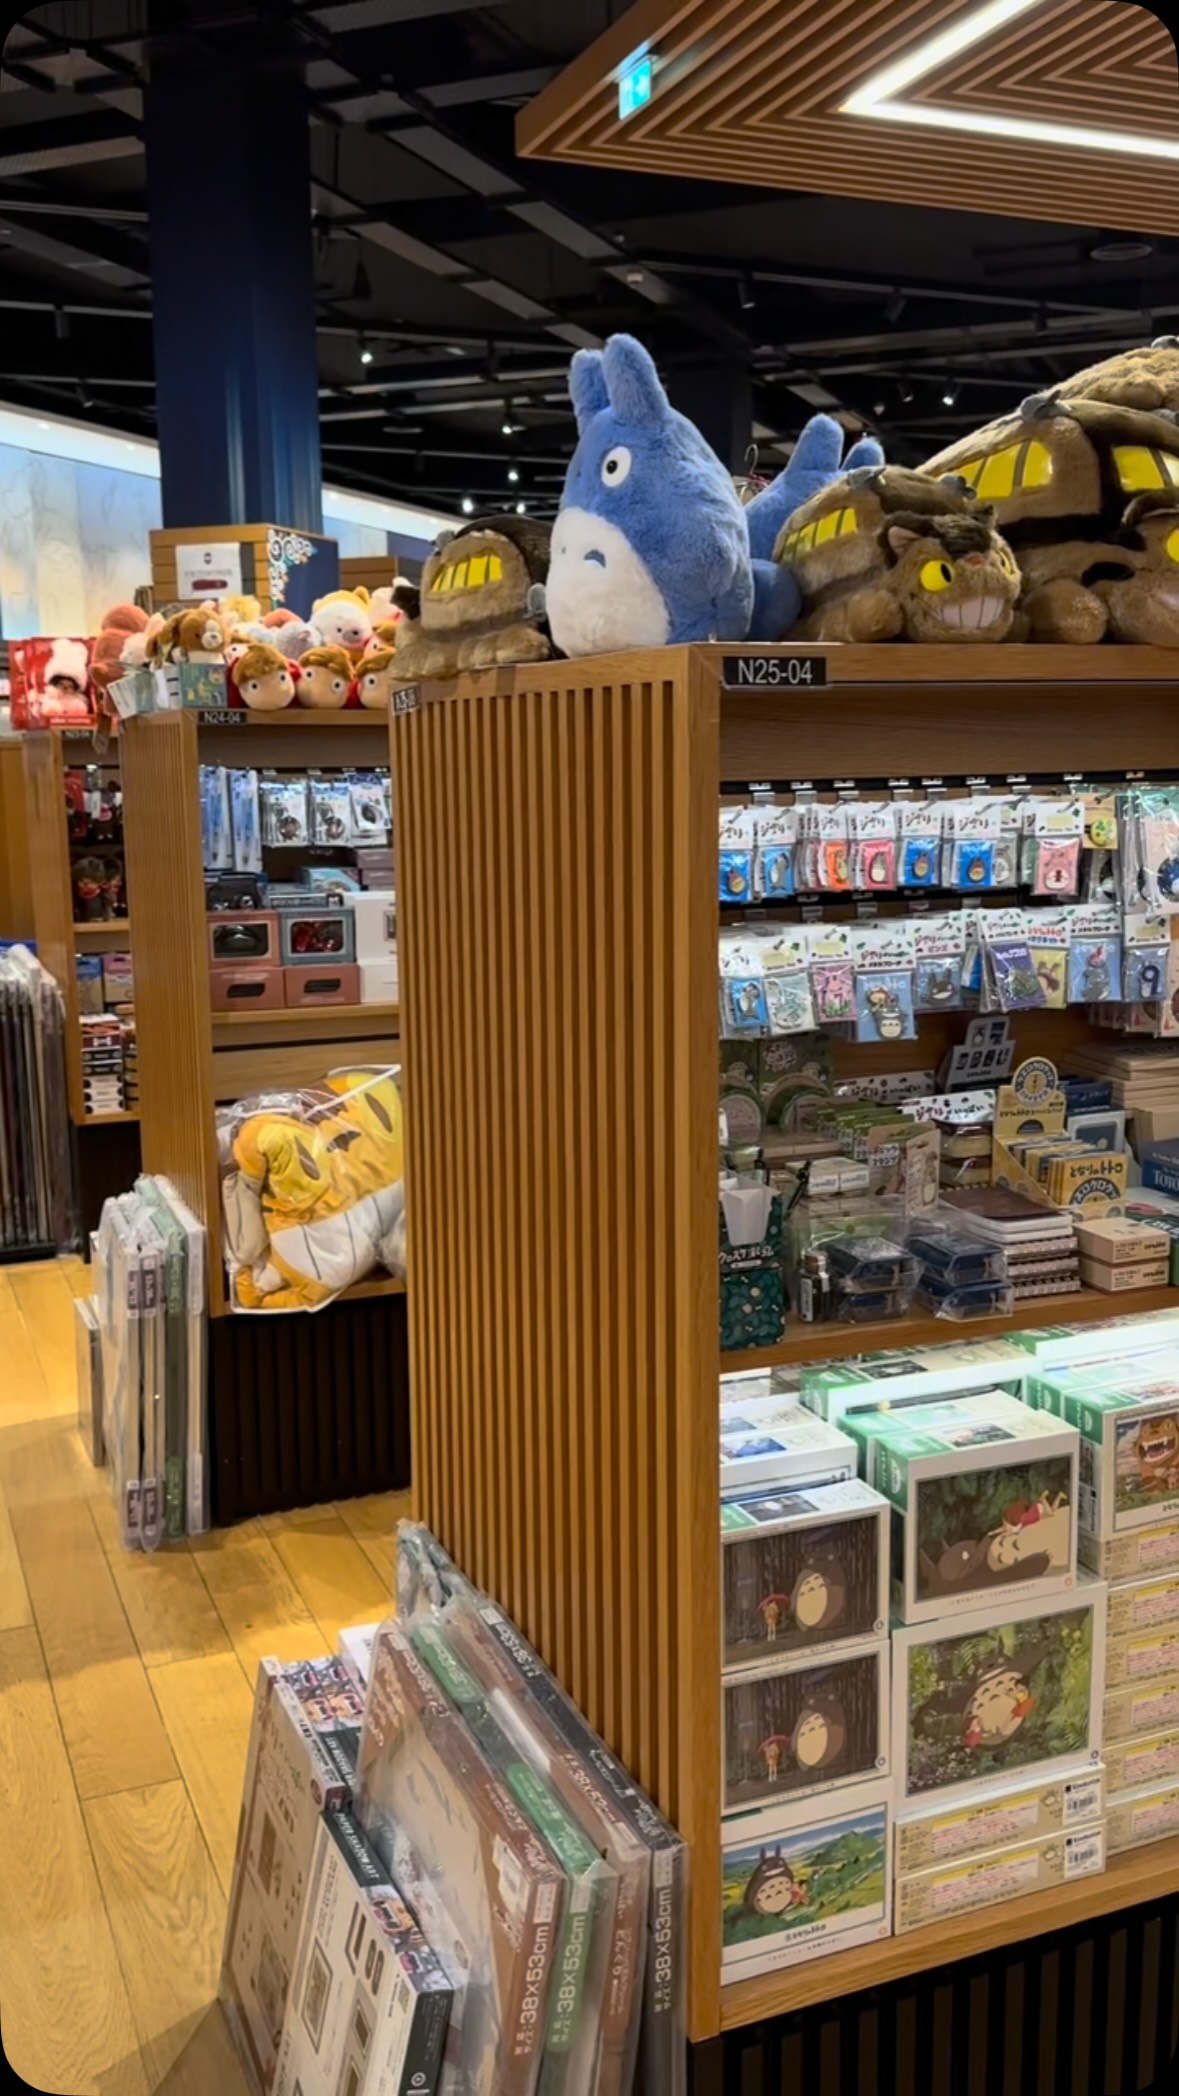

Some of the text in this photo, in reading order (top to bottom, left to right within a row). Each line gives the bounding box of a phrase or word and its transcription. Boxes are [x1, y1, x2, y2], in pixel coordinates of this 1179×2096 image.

[737, 659, 813, 684] N25-04
[204, 712, 242, 723] N24-04
[1070, 1159, 1124, 1178] となりのトトロ
